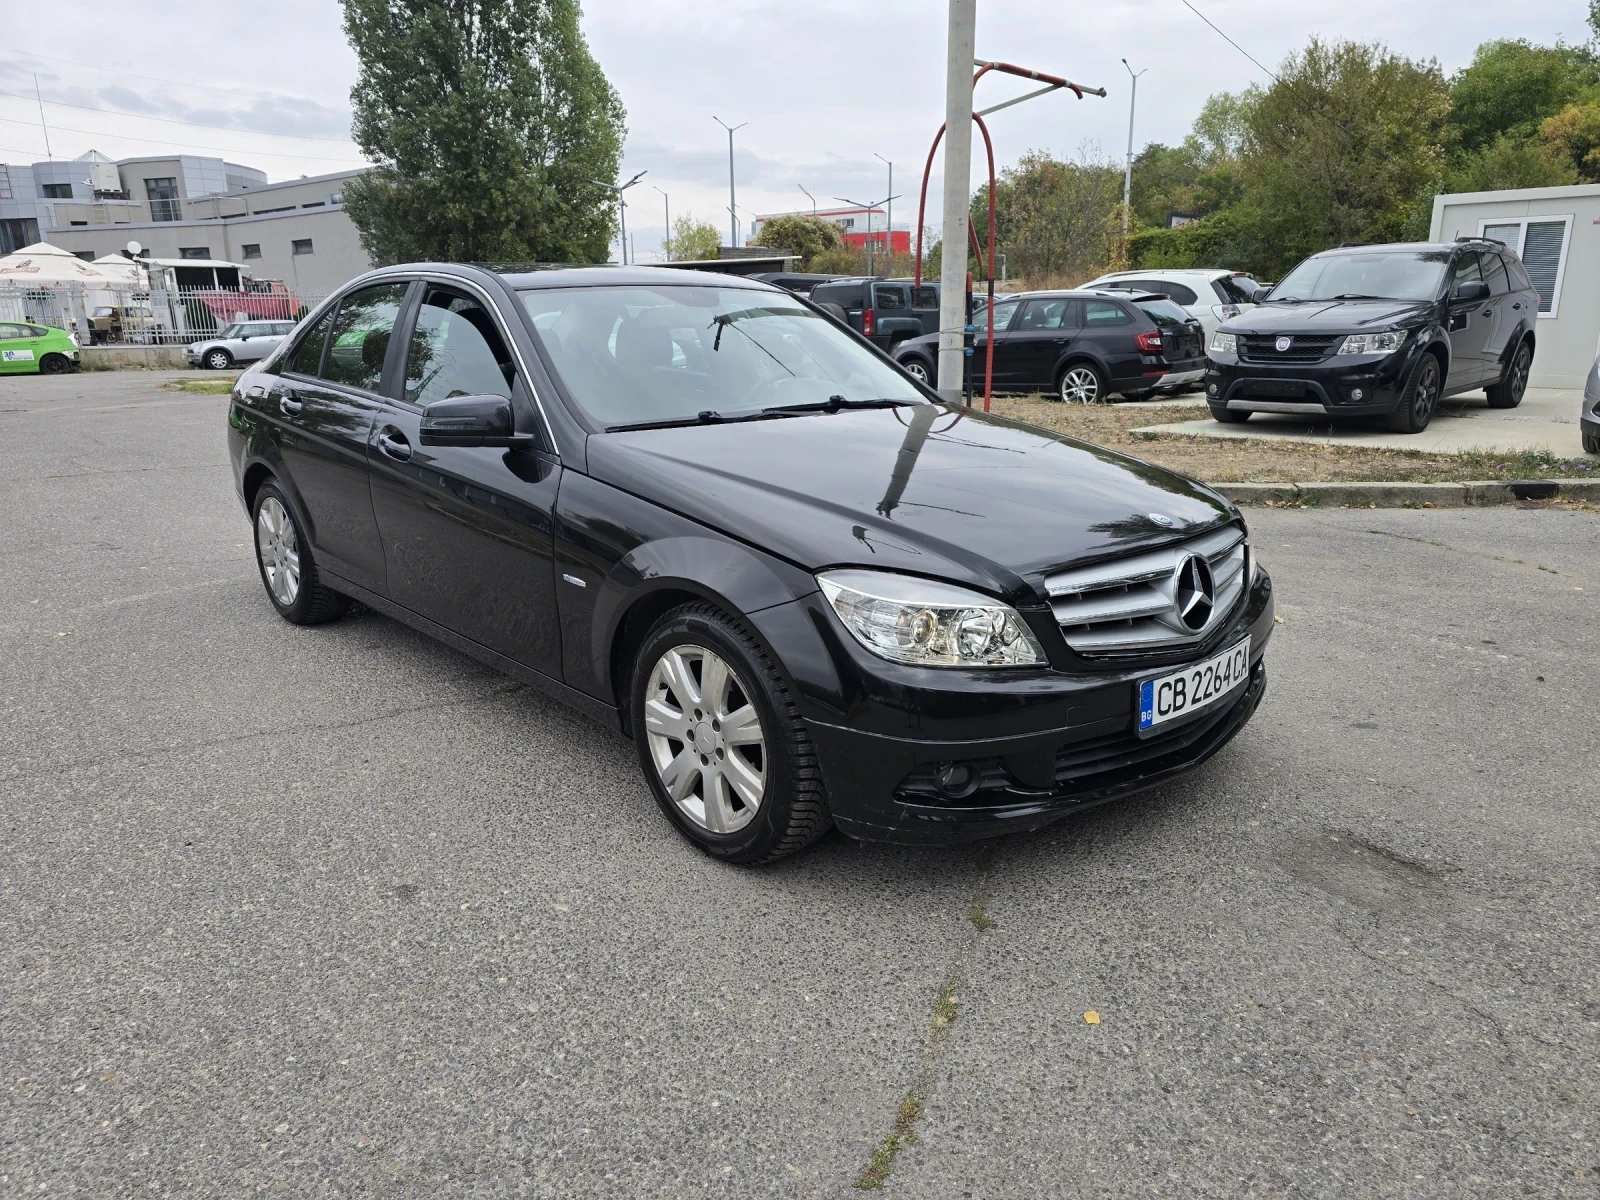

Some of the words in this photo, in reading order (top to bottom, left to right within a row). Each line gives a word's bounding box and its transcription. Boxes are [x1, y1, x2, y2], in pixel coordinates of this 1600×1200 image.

[1157, 677, 1187, 717] CB
[1191, 656, 1231, 706] 2264
[1233, 645, 1248, 682] CA
[1141, 710, 1152, 723] BG
